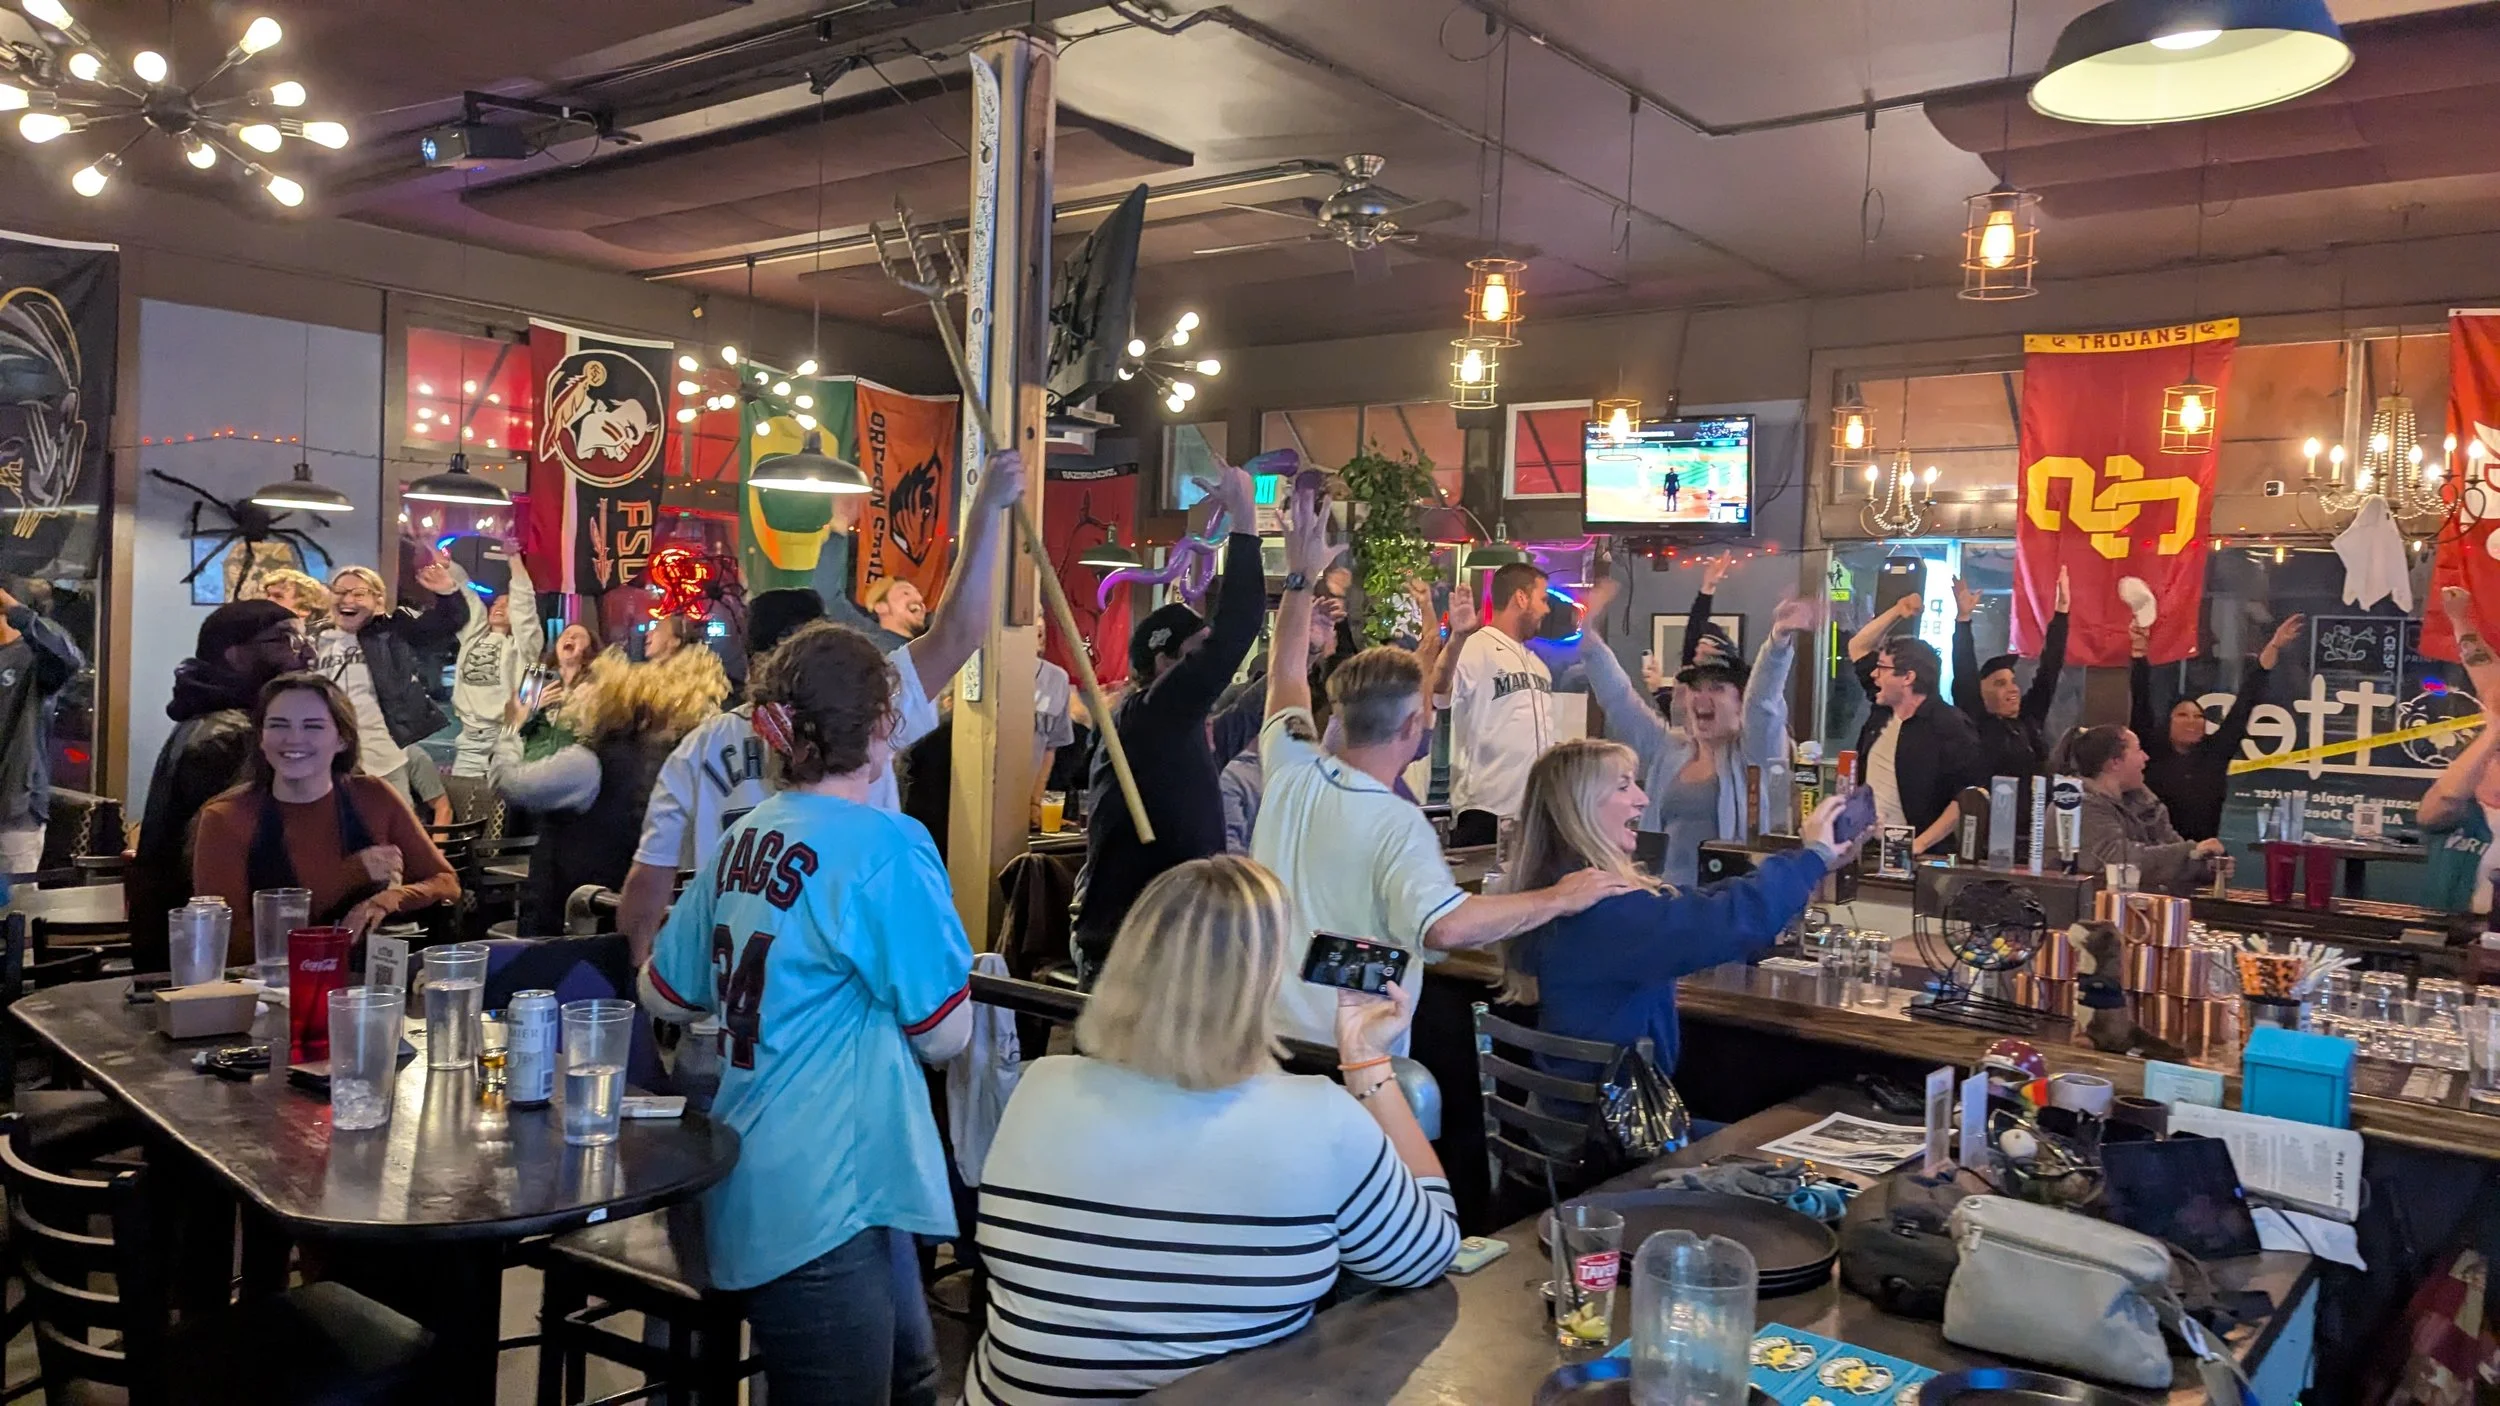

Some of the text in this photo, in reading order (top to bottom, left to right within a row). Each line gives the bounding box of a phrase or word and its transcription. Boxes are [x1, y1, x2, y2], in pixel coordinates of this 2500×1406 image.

[2077, 325, 2188, 349] TROJANS
[1254, 474, 1279, 505] XIT
[616, 499, 654, 586] FSU
